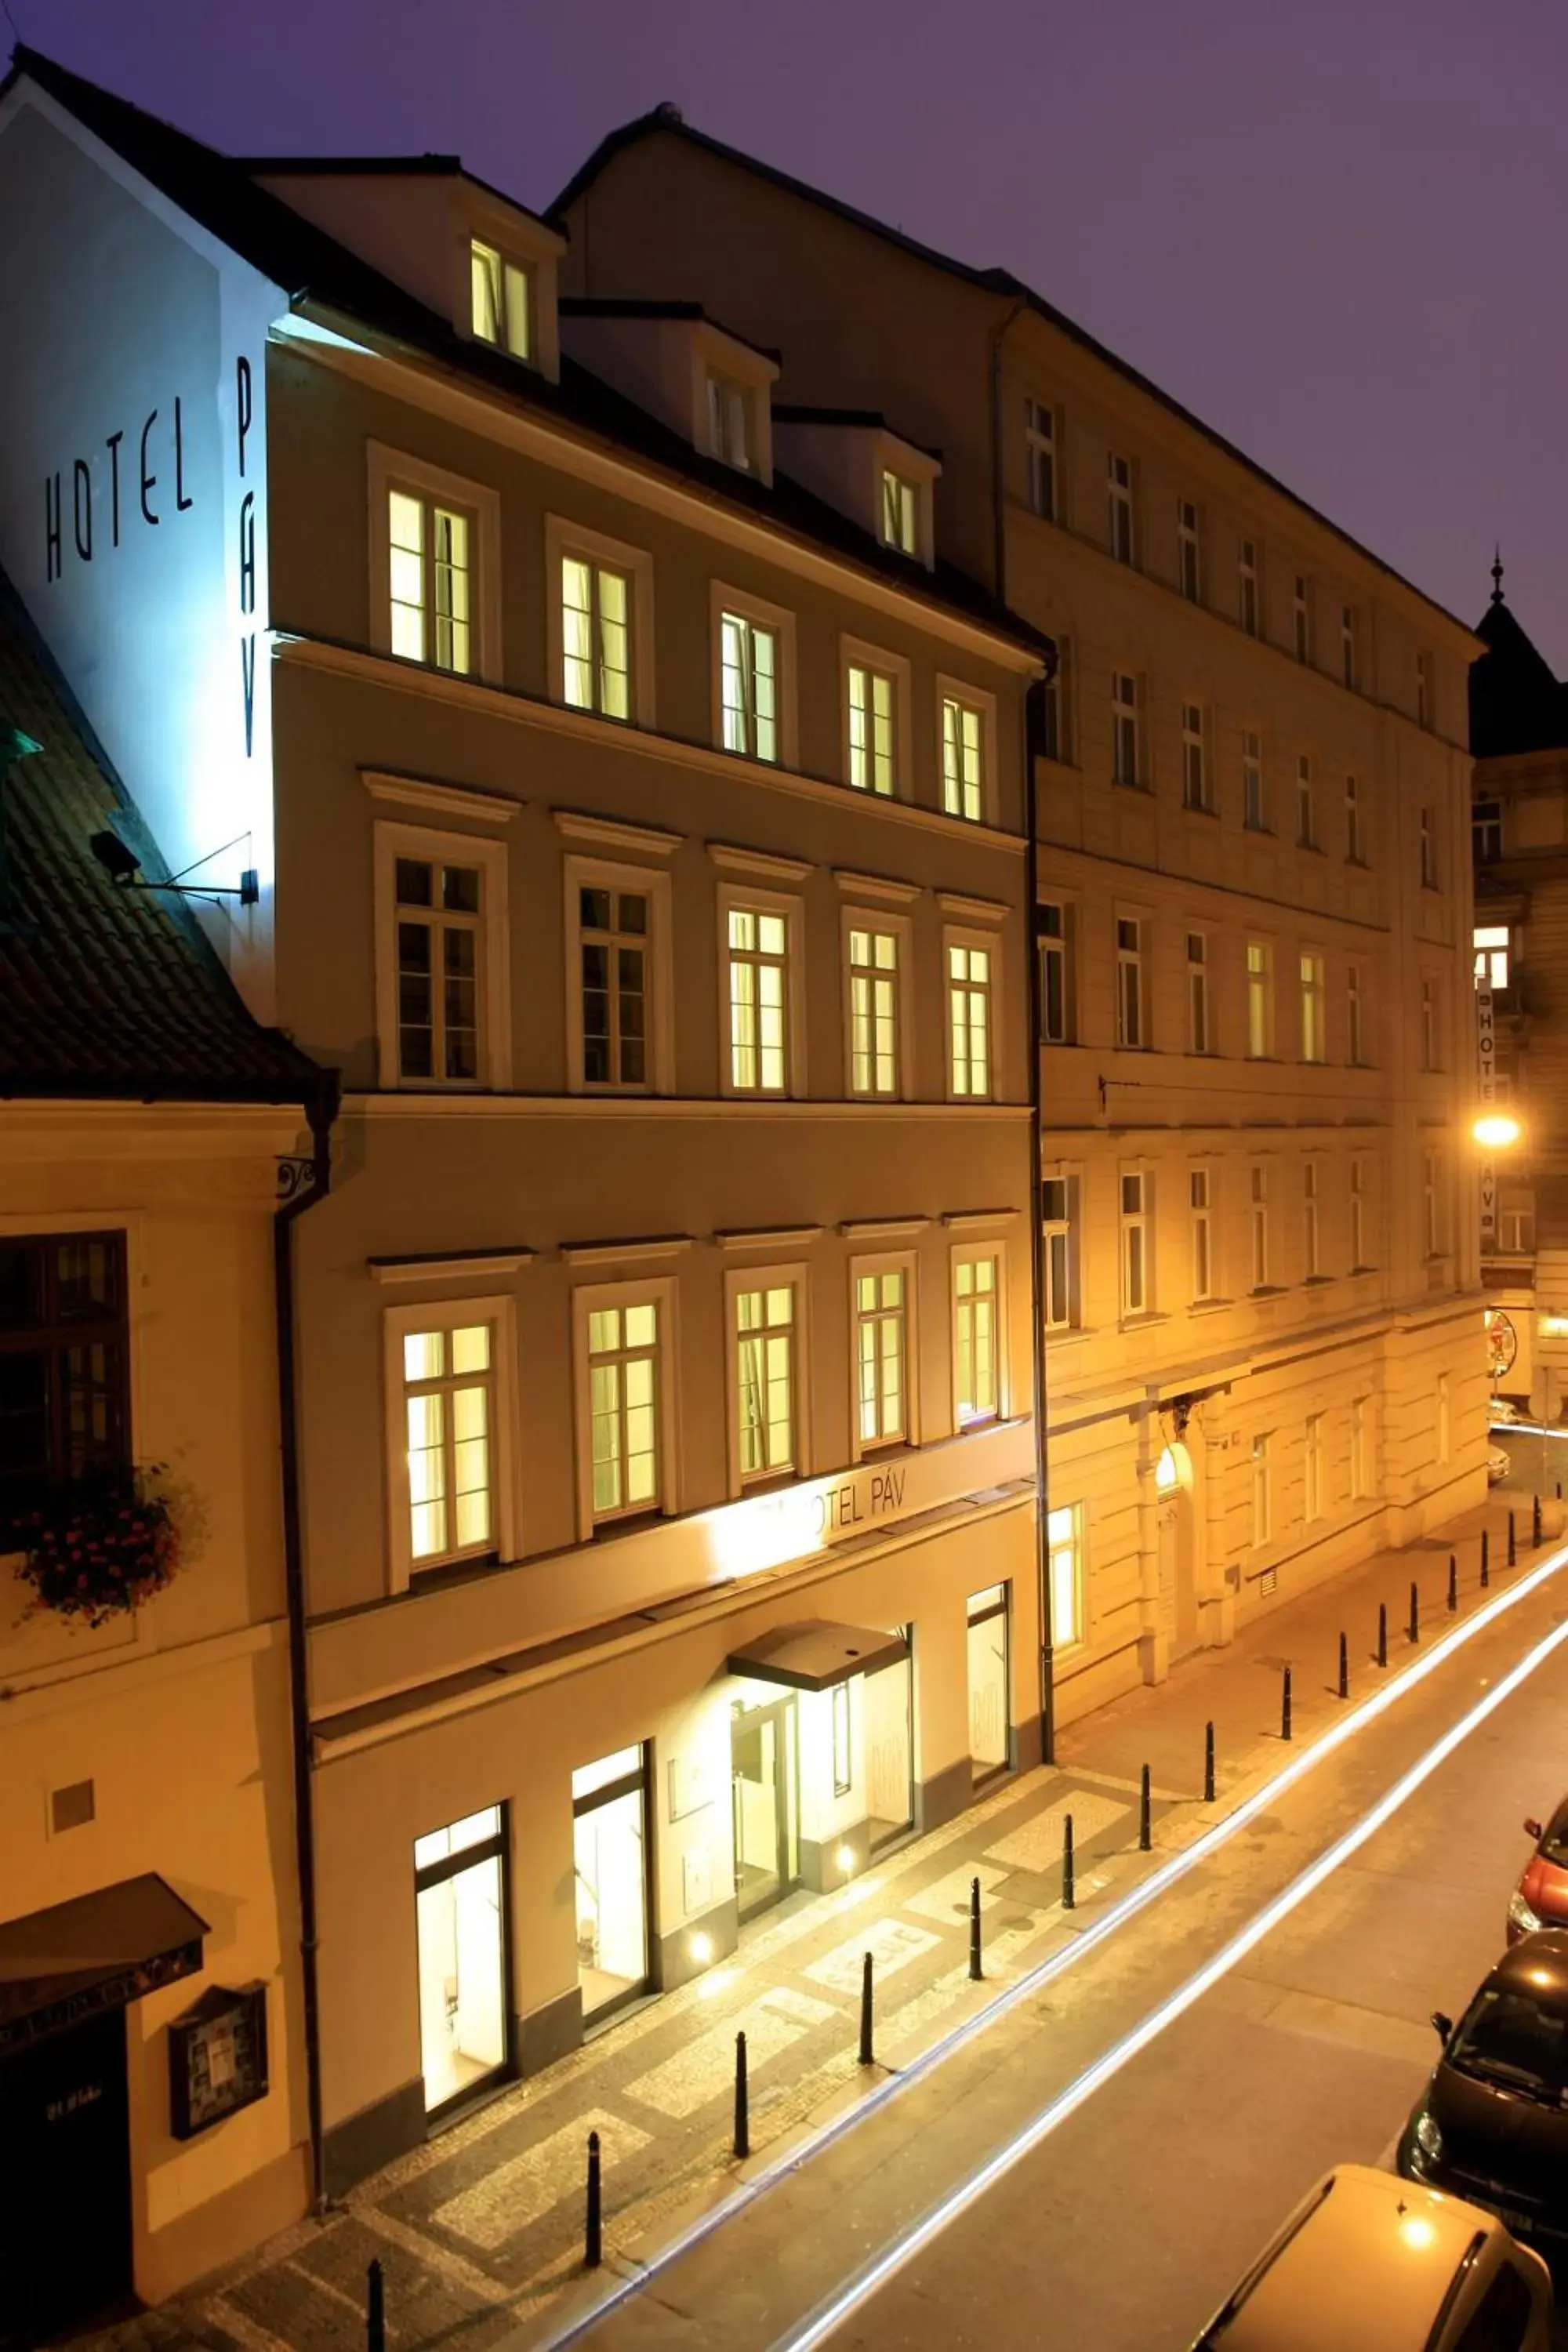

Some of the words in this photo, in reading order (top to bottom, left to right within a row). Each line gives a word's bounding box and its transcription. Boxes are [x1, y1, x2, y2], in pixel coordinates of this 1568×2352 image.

[45, 396, 193, 583] HOTEL
[1480, 1014, 1493, 1100] HOTE
[809, 1484, 864, 1534] OTEL
[870, 1466, 906, 1515] PÁV
